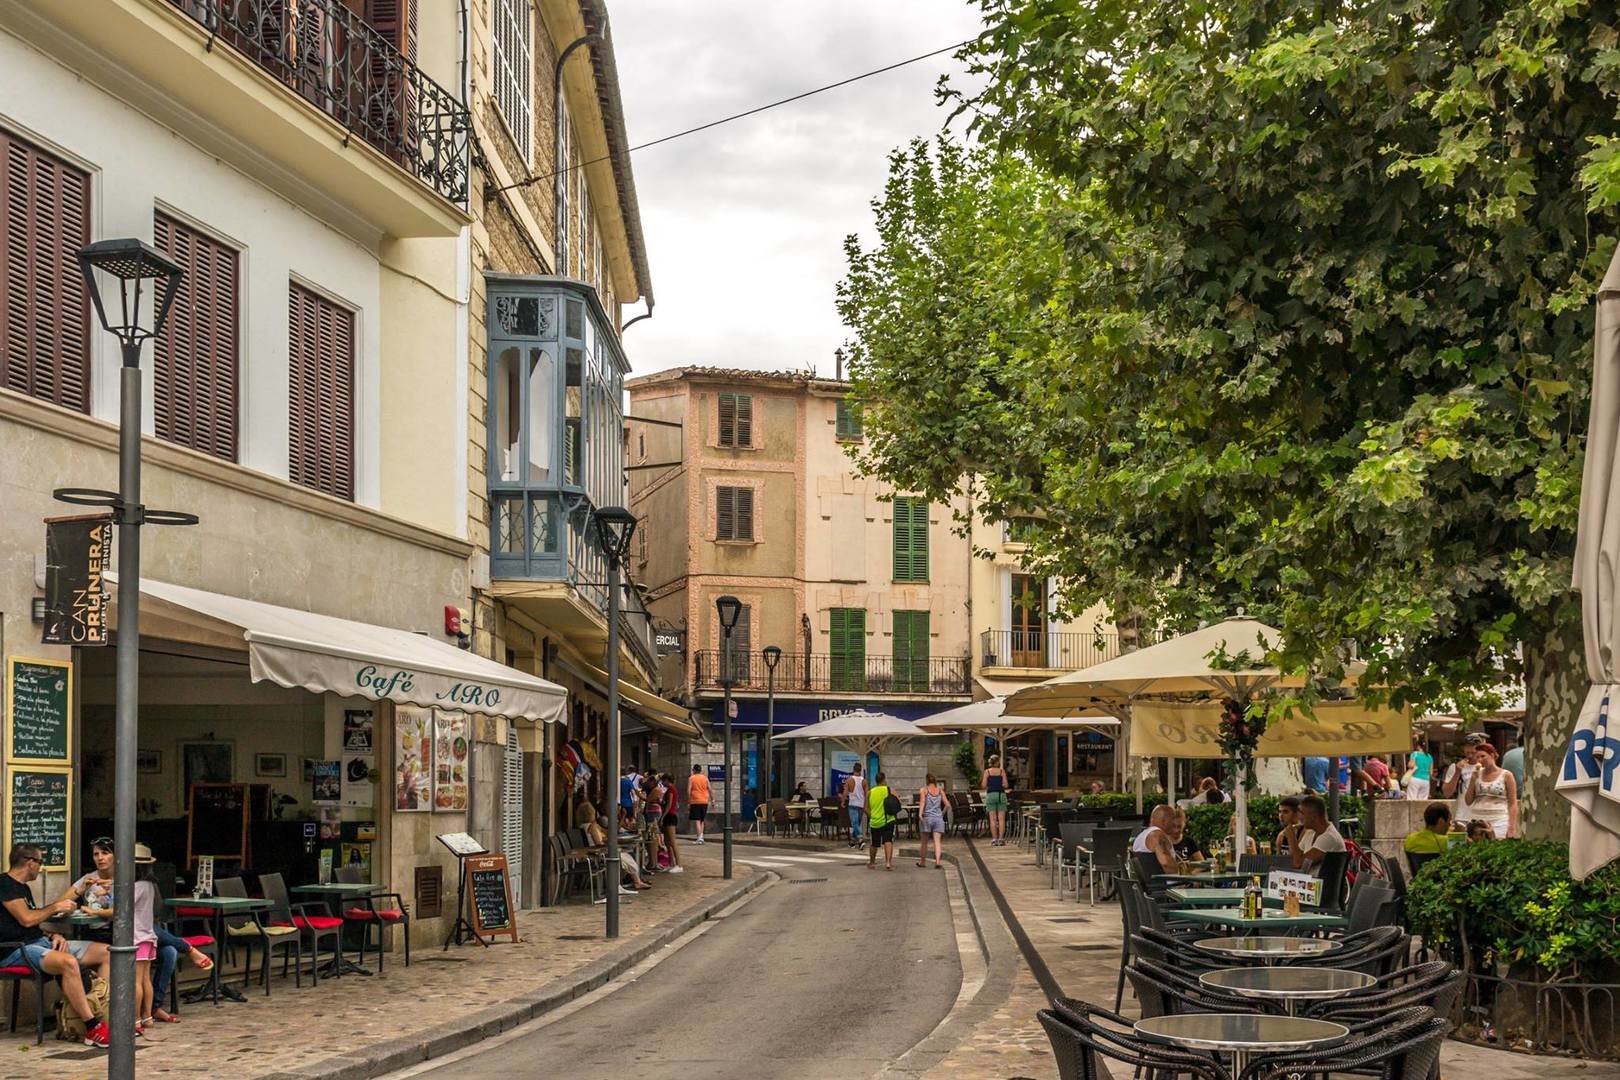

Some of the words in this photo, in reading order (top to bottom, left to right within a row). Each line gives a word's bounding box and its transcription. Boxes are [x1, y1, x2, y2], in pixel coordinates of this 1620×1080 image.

[87, 525, 102, 641] PRUNERA
[71, 590, 87, 641] CAN
[655, 635, 680, 646] ERCIAL
[356, 665, 416, 698] Café
[435, 683, 502, 707] ARO
